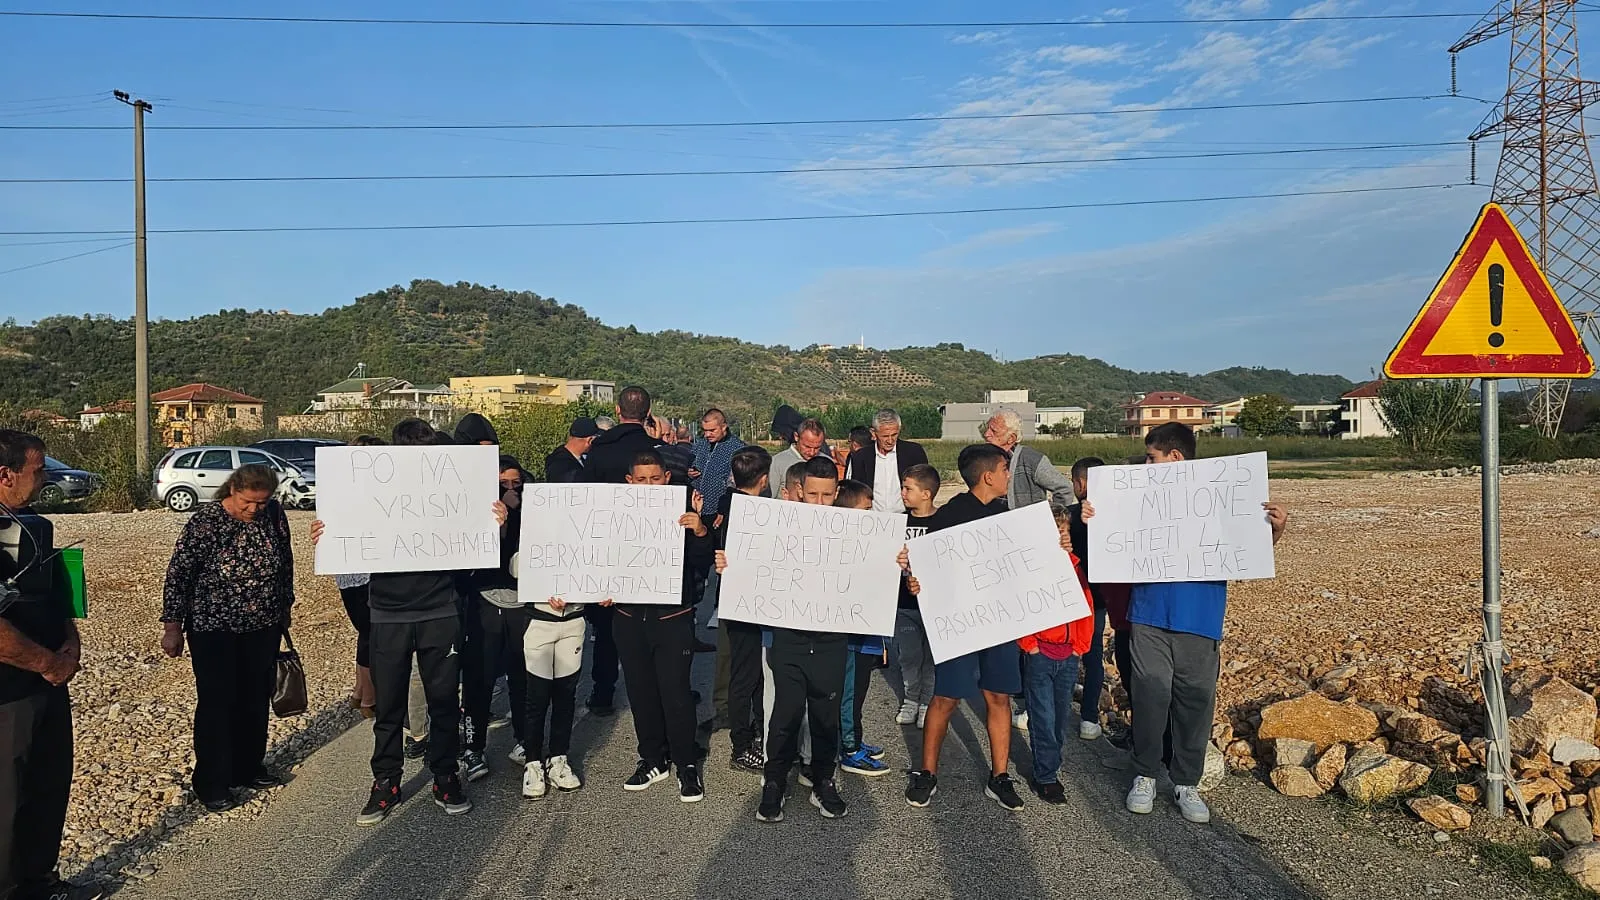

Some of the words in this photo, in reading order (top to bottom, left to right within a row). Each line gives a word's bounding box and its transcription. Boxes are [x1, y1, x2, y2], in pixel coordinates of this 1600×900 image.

[351, 449, 395, 484] PO
[421, 451, 463, 485] NA
[1113, 463, 1196, 491] BERZHI
[533, 486, 595, 509] SHTETI
[742, 500, 772, 527] PO
[777, 504, 801, 530] NA
[904, 527, 928, 541] STA
[932, 523, 1014, 569] PRONA
[1105, 523, 1180, 554] SHTETI
[626, 545, 681, 569] ZONE
[816, 569, 852, 595] TU
[734, 594, 872, 628] ARSIMUAR
